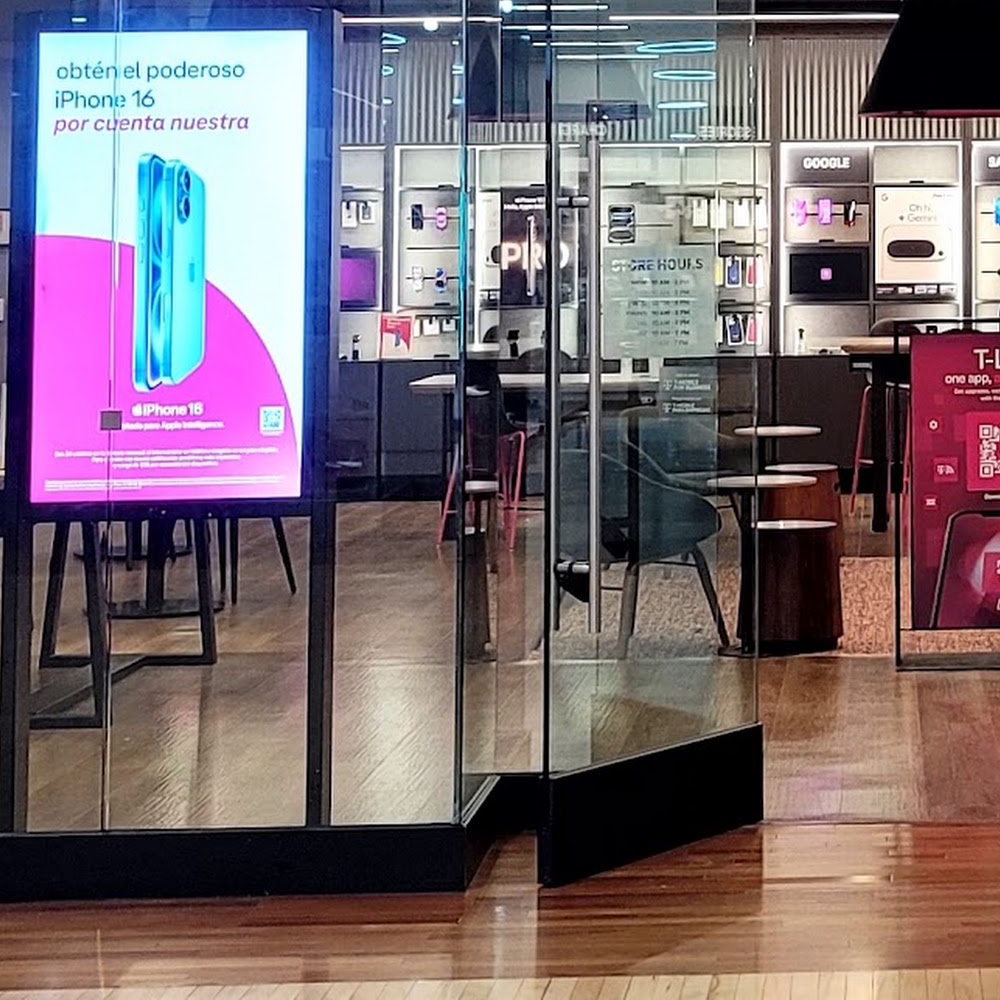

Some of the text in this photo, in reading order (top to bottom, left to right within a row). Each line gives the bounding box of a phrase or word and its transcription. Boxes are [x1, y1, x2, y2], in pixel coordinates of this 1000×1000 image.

[56, 61, 245, 83] obtén el poderoso
[55, 89, 155, 109] iPhone 16
[53, 113, 250, 136] por cuenta nuestra
[803, 156, 851, 169] GOOGLE
[945, 374, 966, 384] one
[968, 373, 992, 386] app,
[143, 402, 188, 417] iPhone
